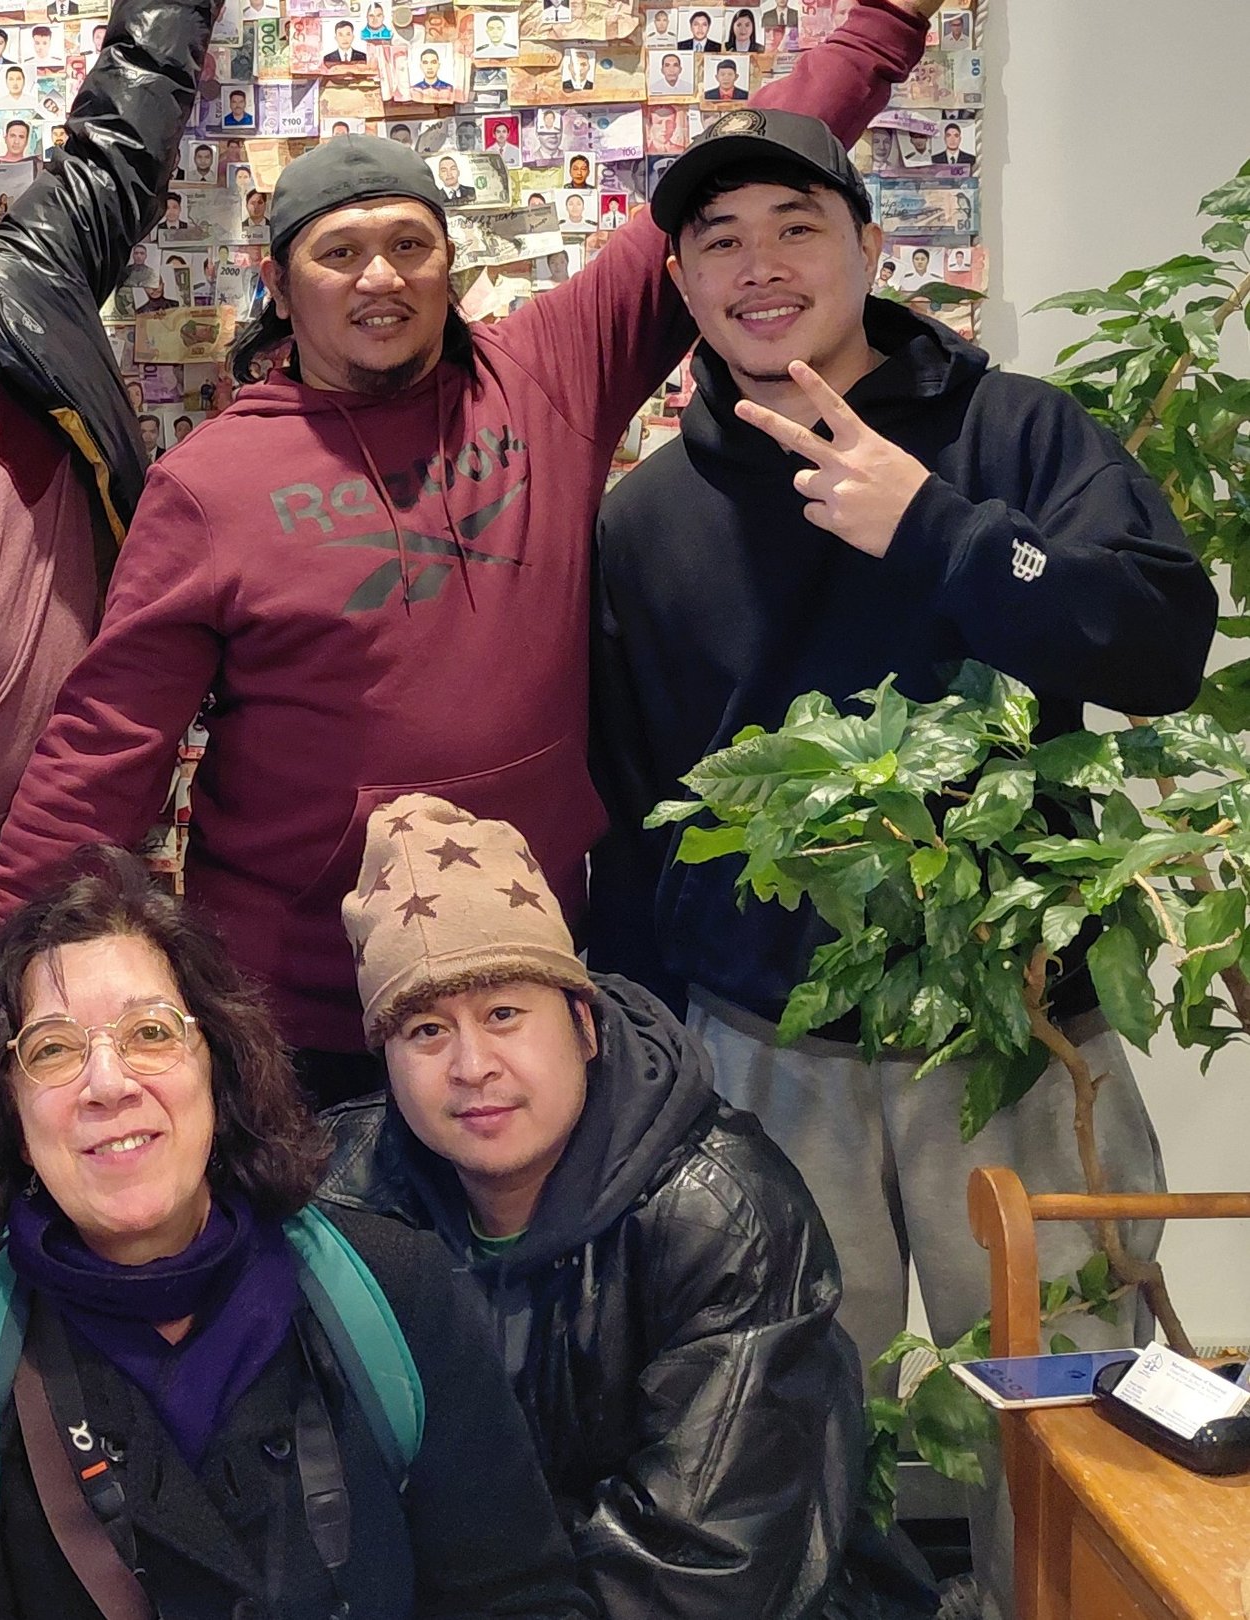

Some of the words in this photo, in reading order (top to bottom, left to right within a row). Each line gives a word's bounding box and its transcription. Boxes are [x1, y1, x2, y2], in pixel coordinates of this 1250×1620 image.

[429, 12, 443, 37] 20
[261, 23, 276, 56] 200
[220, 266, 240, 277] 2000
